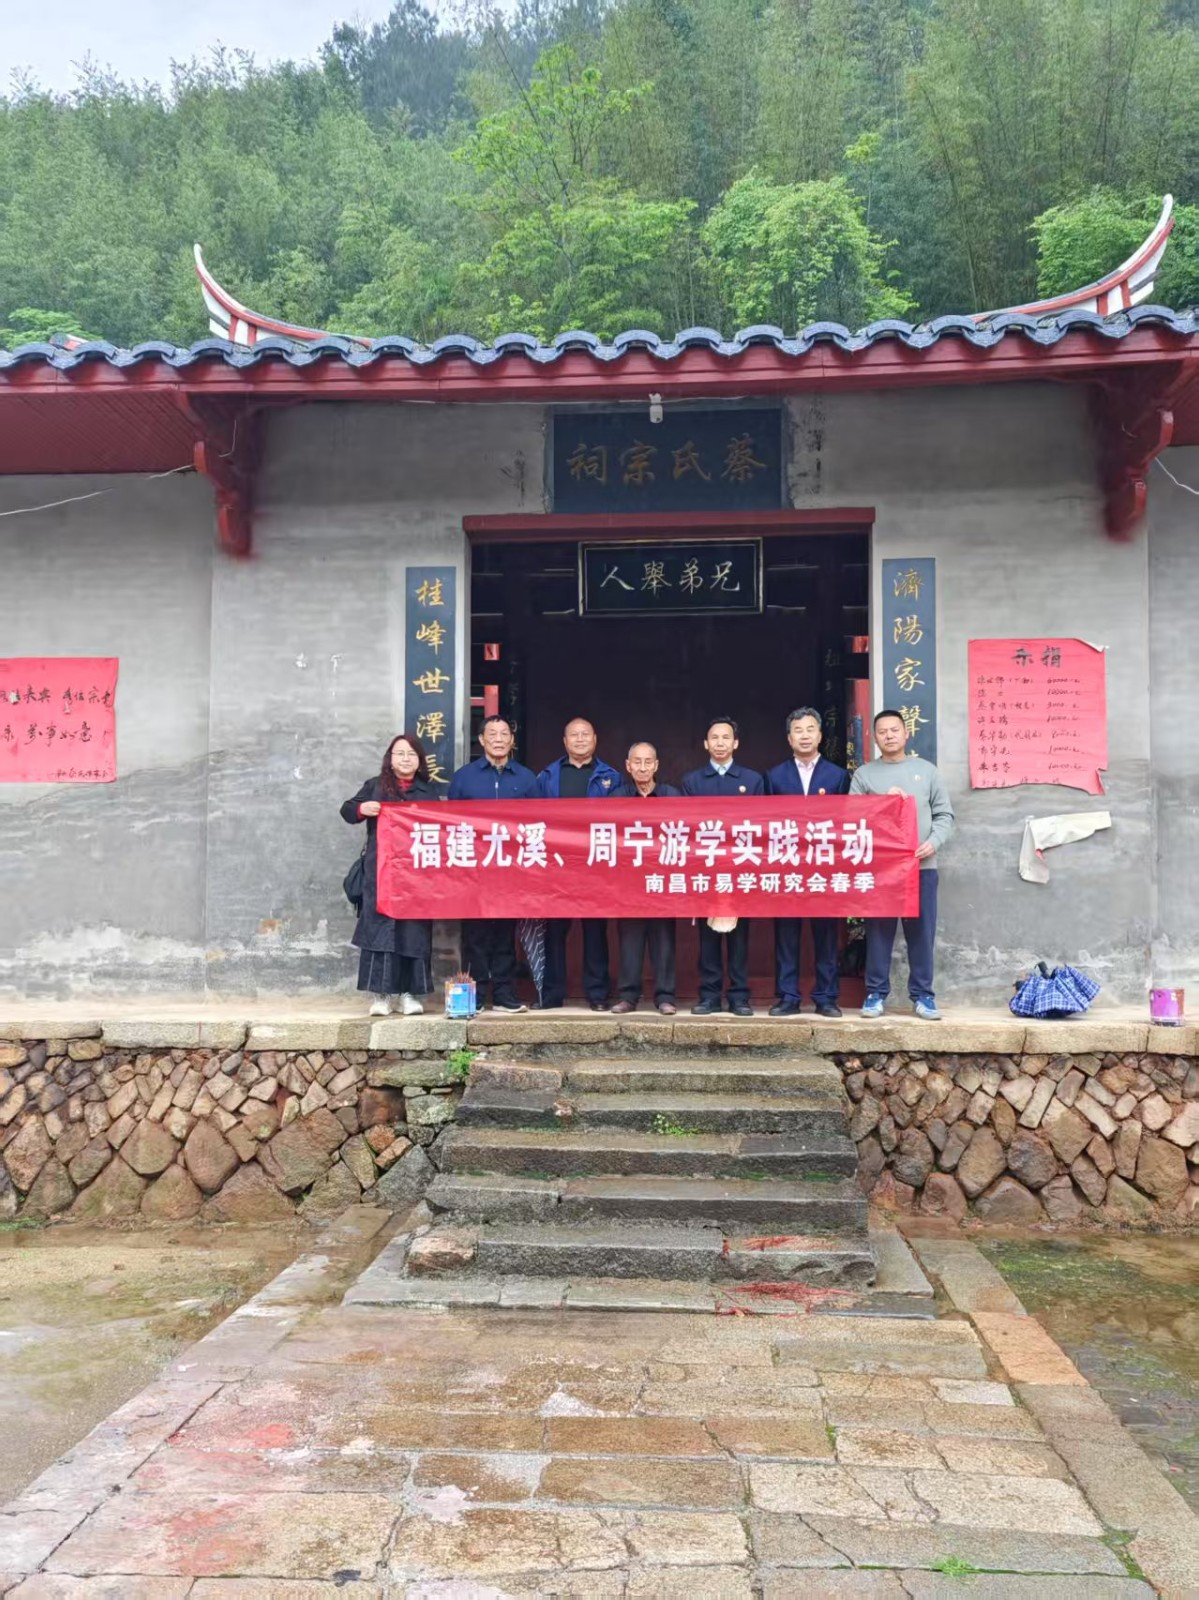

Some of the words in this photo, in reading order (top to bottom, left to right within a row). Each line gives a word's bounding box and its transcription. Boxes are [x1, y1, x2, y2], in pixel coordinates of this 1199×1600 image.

[566, 432, 768, 486] 蔡氏宗祠
[600, 557, 740, 597] 兄弟舉人
[893, 568, 930, 758] 濟陽家聲
[409, 819, 875, 869] 福建尤溪、周宁游学实践活动
[645, 872, 876, 894] 南昌市易学研究会春季
